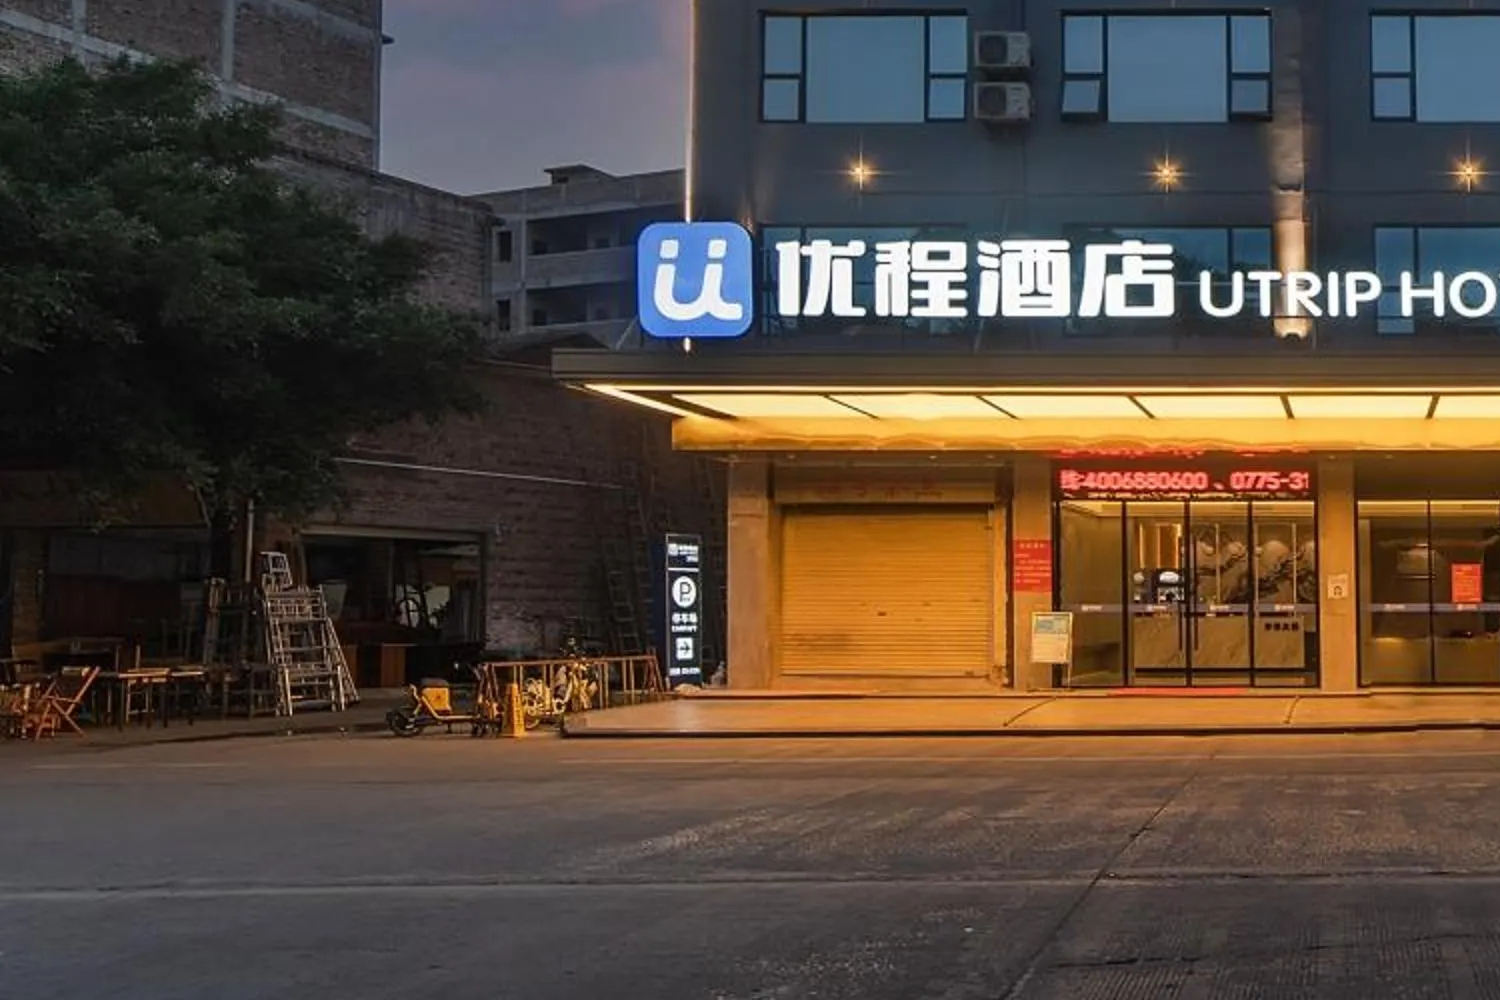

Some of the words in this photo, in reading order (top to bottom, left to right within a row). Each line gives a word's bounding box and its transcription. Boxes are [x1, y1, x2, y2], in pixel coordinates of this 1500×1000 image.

[776, 239, 1175, 317] 优程酒店
[1200, 270, 1381, 317] UTRIP
